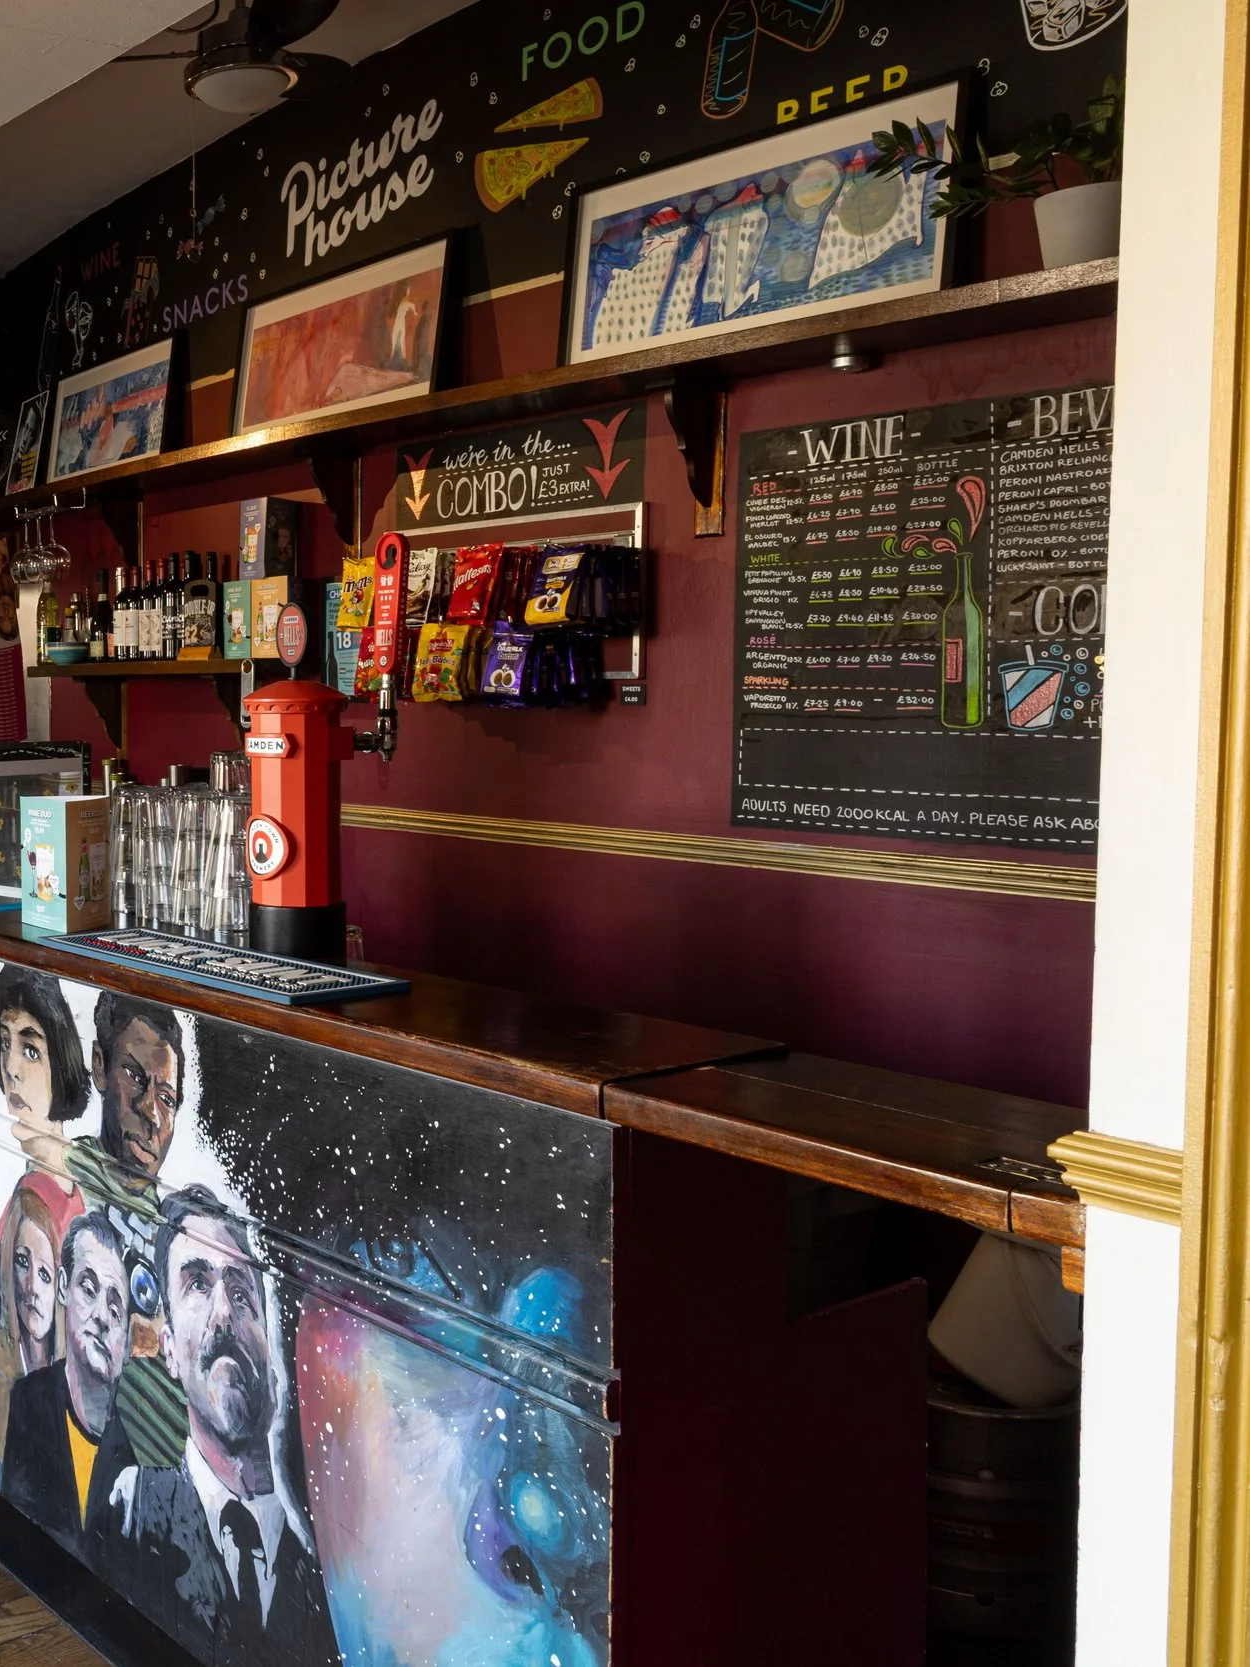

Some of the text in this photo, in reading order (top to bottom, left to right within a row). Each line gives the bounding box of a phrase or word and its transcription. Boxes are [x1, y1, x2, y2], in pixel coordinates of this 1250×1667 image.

[521, 0, 646, 83] FOOD
[280, 98, 443, 258] Picture
[304, 154, 434, 266] house
[80, 242, 120, 282] WINE
[163, 274, 248, 333] SNACKS
[799, 415, 904, 466] WINE
[442, 444, 488, 470] we're
[493, 440, 515, 461] in
[1000, 441, 1100, 464] CAMDEN HELLS
[542, 463, 571, 478] JUST
[810, 459, 958, 484] 125ml 175ml 250ml BOTTLE
[999, 454, 1113, 476] BRIXTON RELIANC
[538, 479, 590, 498] £3 EXTRA!
[752, 482, 777, 494] RED
[999, 475, 1042, 489] PERONI
[437, 465, 537, 518] COMBO!
[998, 485, 1078, 501] PERONI CAPRI
[998, 495, 1107, 514] SHARP'S DOOMBAR
[750, 520, 779, 529] MERLOT
[998, 509, 1092, 525] CAMDEN HELLS
[755, 532, 782, 540] OSCURO
[998, 524, 1048, 535] ORCHARD
[1049, 523, 1068, 531] PIG
[747, 541, 780, 549] MALBEC
[997, 535, 1076, 547] KOPPARBERG
[751, 553, 780, 563] WHITE
[996, 550, 1044, 559] PERONI
[1051, 549, 1068, 558] 0%
[337, 632, 352, 649] 18
[376, 629, 393, 646] HELLS
[750, 633, 776, 645] ROSÉ
[746, 652, 786, 661] ARGENTO
[744, 675, 789, 686] SPARKLING
[743, 693, 787, 702] VAPORETTO
[247, 740, 284, 751] CAMDEN
[41, 810, 52, 819] DUO
[80, 811, 96, 819] BEER
[741, 798, 787, 813] ADULTS
[793, 803, 830, 817] NEED
[917, 812, 926, 822] A
[931, 811, 965, 824] DAY.
[970, 813, 1029, 828] PLEASE
[1033, 815, 1067, 830] ASK
